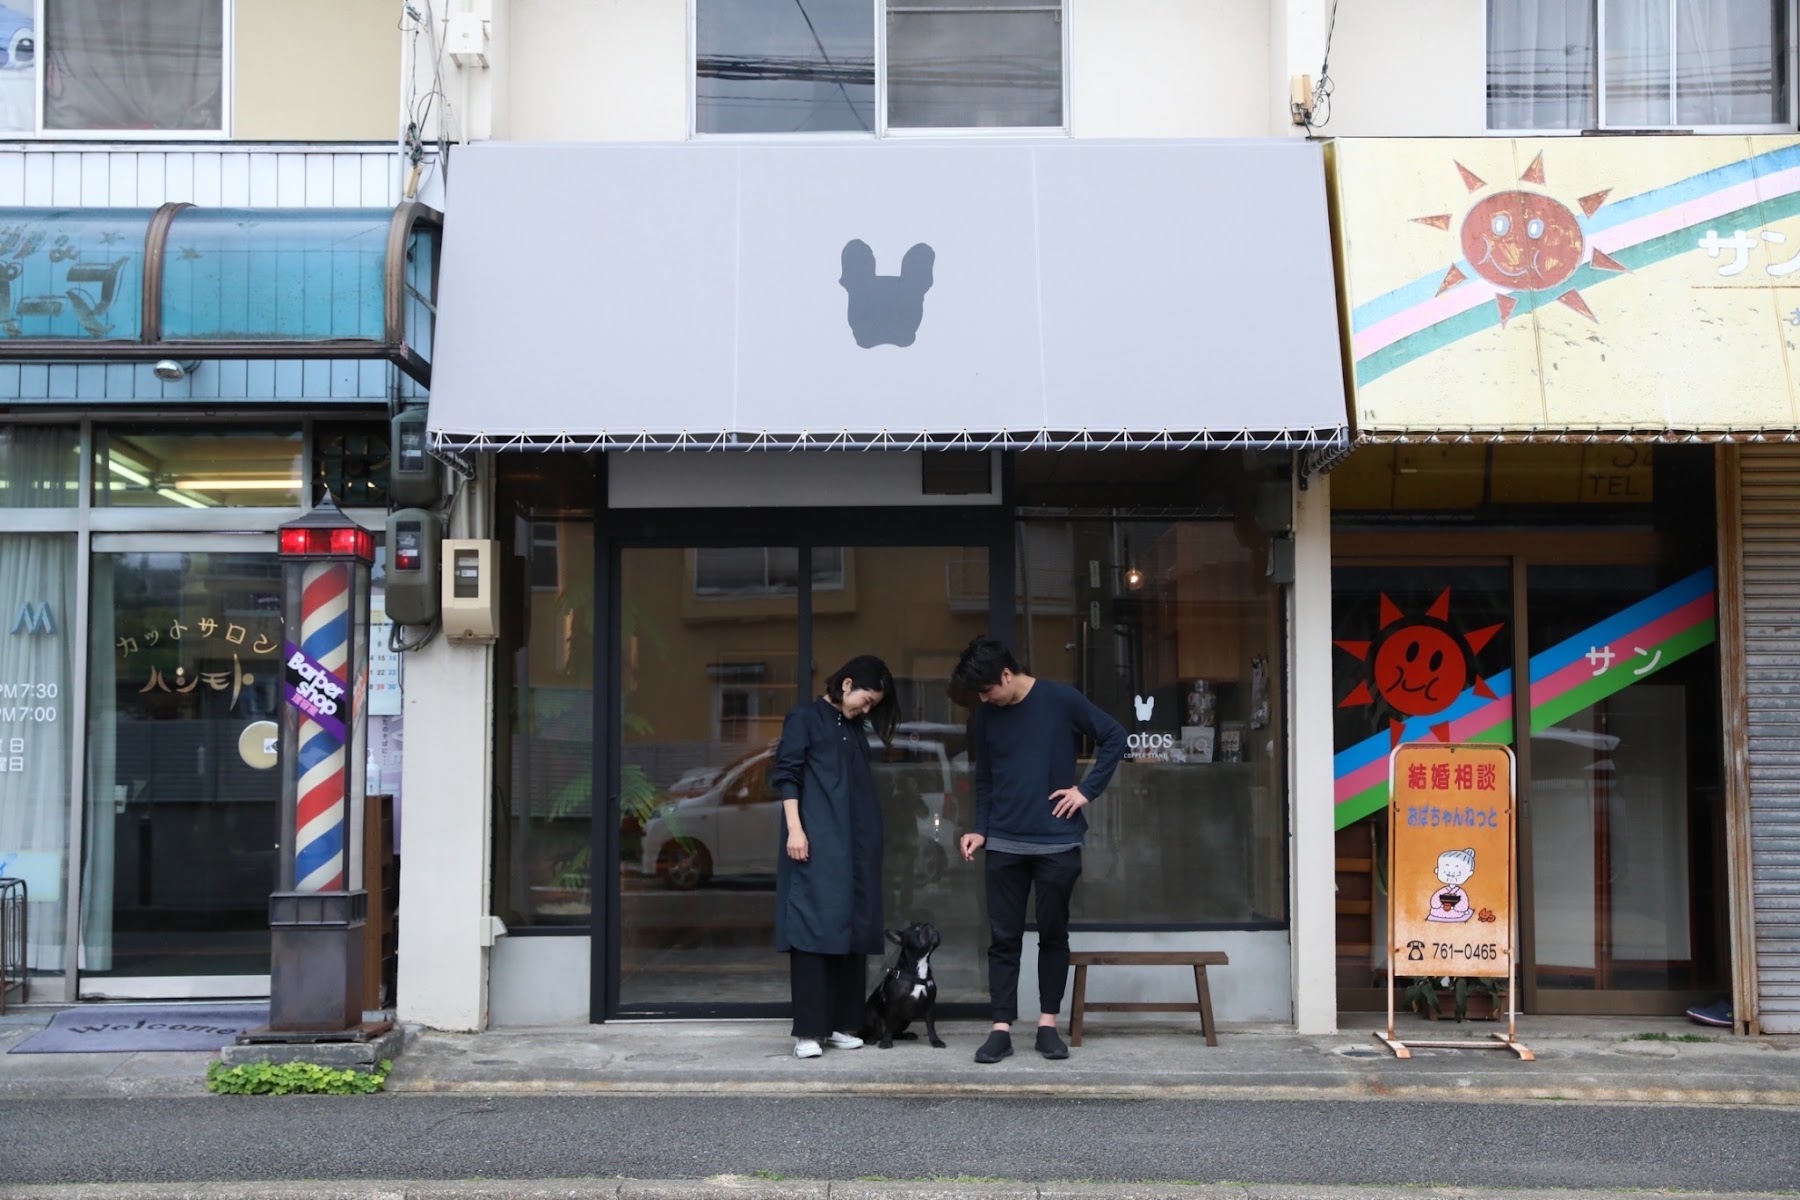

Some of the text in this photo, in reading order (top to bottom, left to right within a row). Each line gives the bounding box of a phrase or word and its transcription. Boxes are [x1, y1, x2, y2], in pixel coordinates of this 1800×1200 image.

[1698, 229, 1800, 277] サン
[287, 651, 345, 699] Barber
[1584, 646, 1662, 677] サン
[296, 681, 338, 716] shop
[1125, 731, 1173, 749] otos
[1408, 763, 1497, 791] 結婚相談
[1407, 806, 1498, 829] おばちゃんねっと
[1432, 942, 1498, 961] 761-0465
[68, 1019, 237, 1035] Welcome
